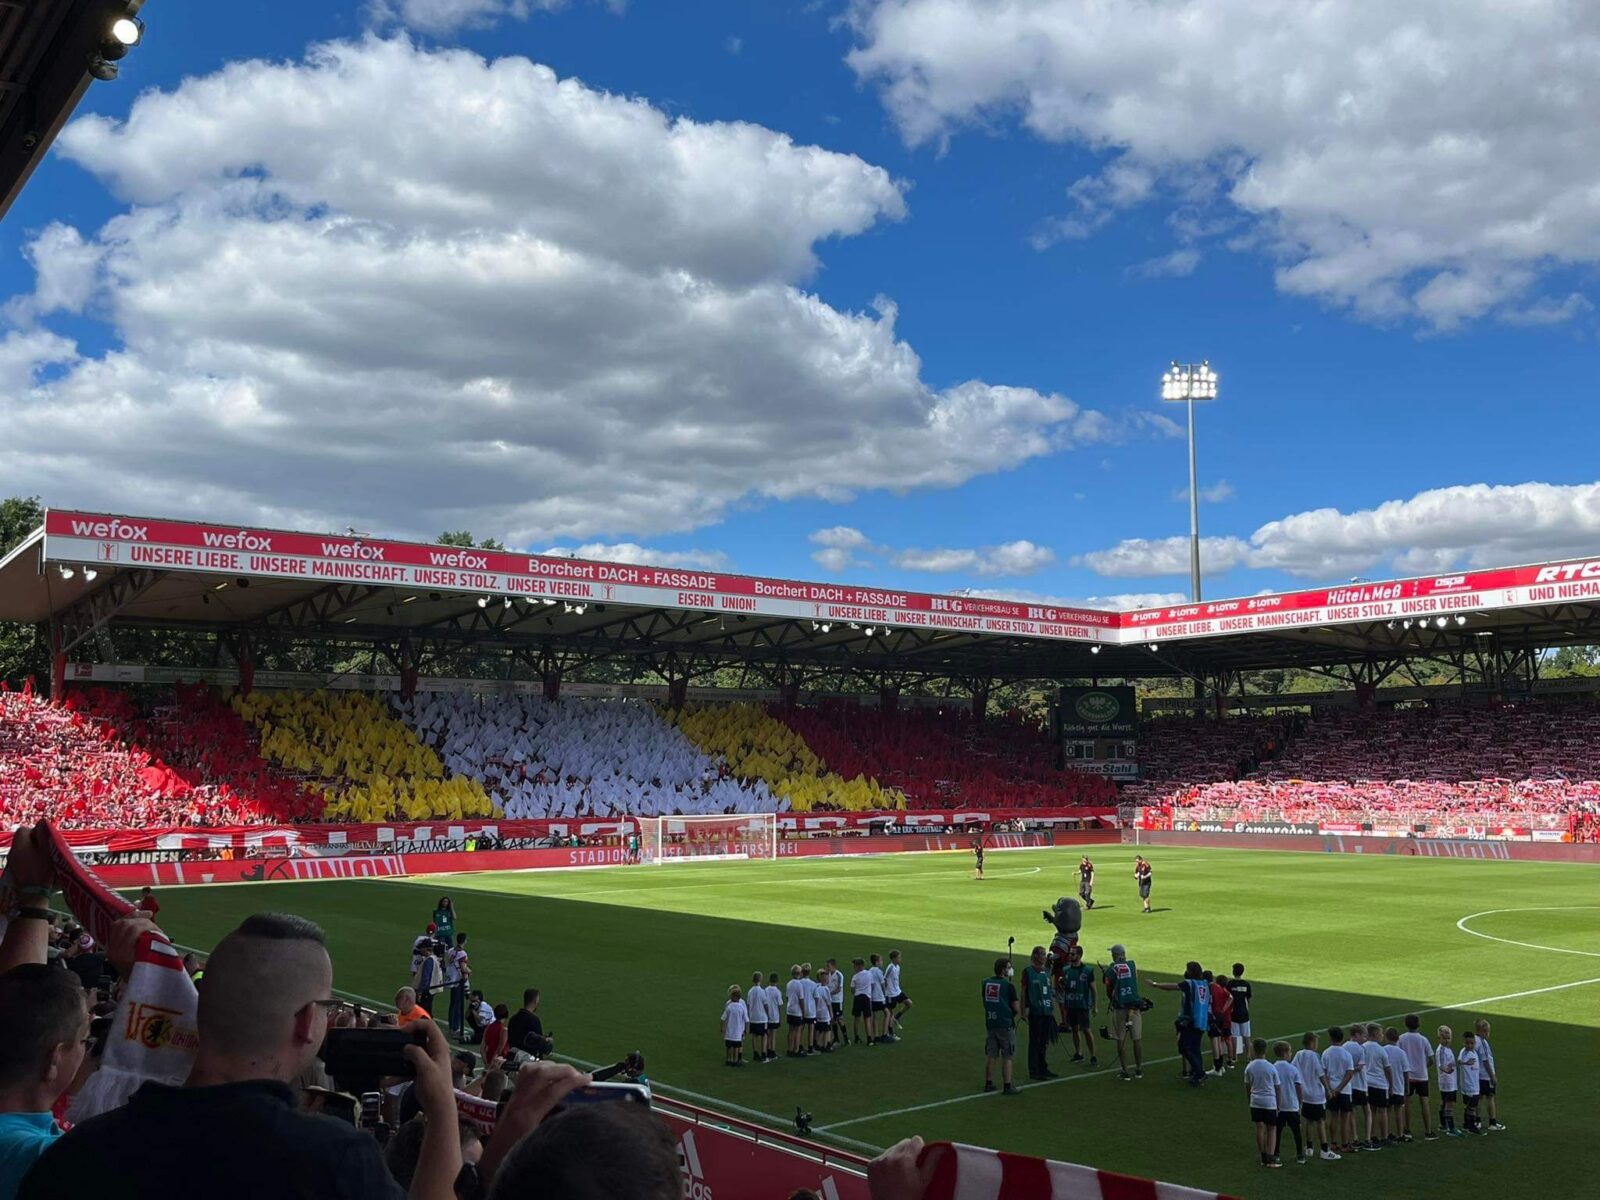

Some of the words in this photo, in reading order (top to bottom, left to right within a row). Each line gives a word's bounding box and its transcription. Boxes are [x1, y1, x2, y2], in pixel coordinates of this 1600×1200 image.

[71, 519, 147, 541] wefox
[203, 531, 272, 551] wefox
[321, 541, 384, 560] wefox
[430, 551, 487, 570] wefox
[130, 546, 193, 566] UNSERE
[196, 553, 243, 570] LIEBE.
[250, 557, 307, 575] UNSERE
[312, 561, 408, 582] MANNSCHAFT.
[414, 569, 456, 586] UNSER
[460, 573, 500, 589] STOLZ.
[507, 577, 545, 594] UNSER
[549, 581, 593, 598] VEREIN.
[528, 559, 594, 578] Borchert
[598, 566, 638, 583] DACH
[654, 572, 716, 590] FASSADE
[678, 592, 714, 608] EISERN
[721, 596, 756, 611] UNION!
[755, 581, 807, 598] Borchert
[811, 587, 843, 601] DACH
[855, 591, 907, 607] FASSADE
[1256, 597, 1281, 607] LOTTO
[1529, 586, 1555, 601] UND
[963, 602, 1012, 615] VERKEHRSBAU
[1012, 607, 1019, 615] SE
[1139, 611, 1161, 621] LOTTO
[1156, 624, 1188, 637] UNSERE
[1189, 621, 1215, 634] LIEBE.
[1219, 617, 1254, 631] UNSERE
[1257, 610, 1322, 627] MANNSCHAFT.
[1327, 608, 1359, 620] UNSER
[1362, 603, 1397, 617] STOLZ.
[1401, 599, 1437, 613] UNSER
[1440, 594, 1483, 610] VEREIN.
[1176, 607, 1199, 617] LOTTO
[1216, 602, 1239, 613] LOTTO
[828, 605, 862, 621] UNSERE
[864, 608, 890, 622] LIEBE.
[894, 611, 927, 625] UNSERE
[929, 614, 983, 630] MANNSCHAFT.
[986, 618, 1011, 632] UNSER
[1012, 621, 1036, 634] STOLZ.
[1039, 624, 1062, 636] UNSER
[1064, 626, 1091, 638] VEREIN.
[1058, 612, 1101, 623] VERKEHRSBAU
[1102, 615, 1109, 624] SE
[1120, 986, 1133, 997] 22
[987, 1011, 997, 1020] 36
[682, 1173, 713, 1200] das
